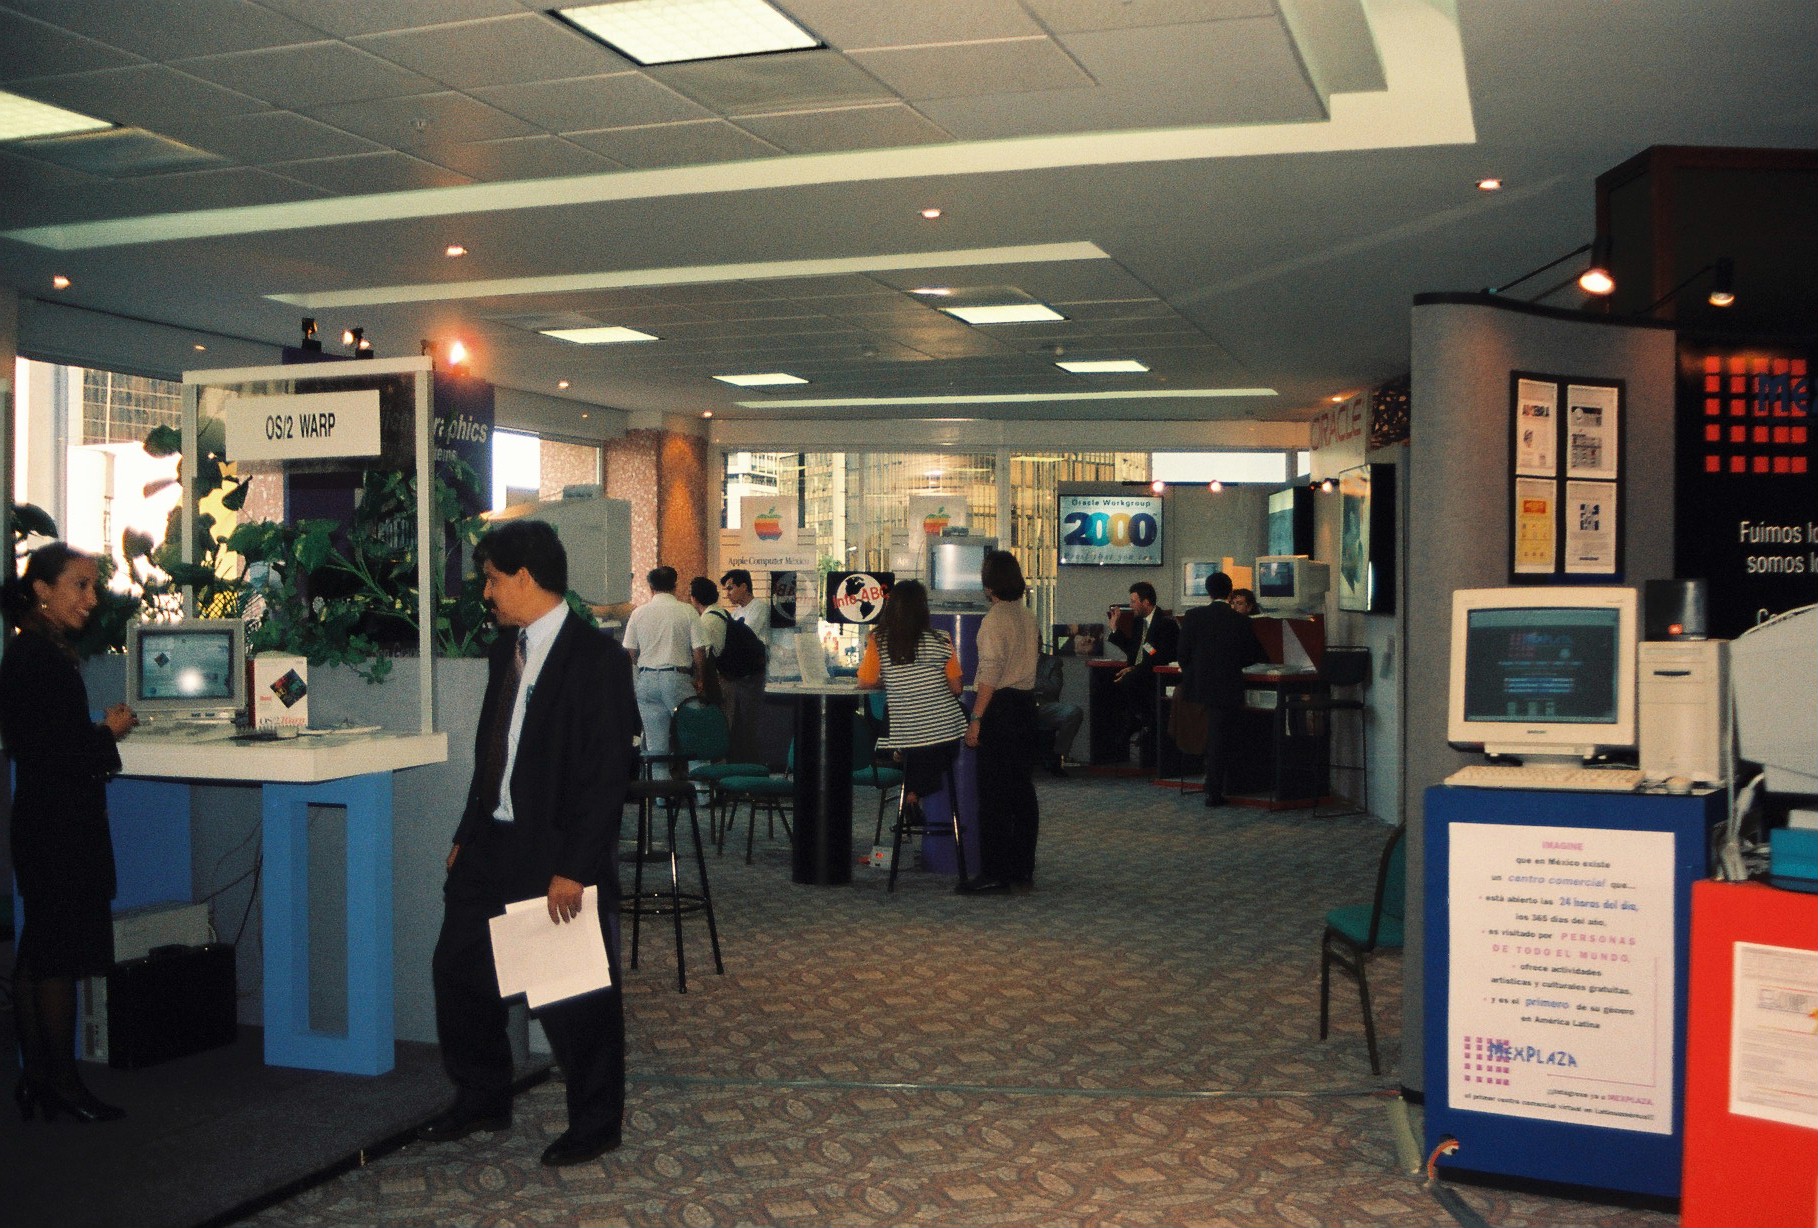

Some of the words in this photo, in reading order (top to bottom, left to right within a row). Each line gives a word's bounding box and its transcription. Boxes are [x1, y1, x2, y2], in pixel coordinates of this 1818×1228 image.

[265, 414, 293, 440] OS/2
[299, 412, 336, 438] WARP
[1310, 398, 1362, 451] ORACLE
[1071, 498, 1100, 507] Oracle
[1103, 499, 1151, 508] Workgroup
[1063, 511, 1158, 548] 2000
[1740, 520, 1803, 543] Fuimos
[728, 557, 749, 568] Apple
[749, 557, 784, 567] Computer
[1746, 554, 1805, 573] somos
[833, 594, 858, 610] Info
[860, 584, 889, 602] ABC
[1541, 841, 1584, 851] IMAGINE
[1515, 857, 1531, 866] que
[1583, 860, 1611, 869] existe
[1508, 874, 1545, 885] centro
[1549, 876, 1606, 888] comercial
[1507, 896, 1538, 905] abierto
[1559, 897, 1572, 907] 24
[1574, 898, 1600, 909] horas
[1603, 900, 1618, 910] del
[1515, 913, 1530, 921] los
[1531, 914, 1548, 922] 365
[1572, 916, 1585, 925] del
[1501, 928, 1536, 938] visitado
[1538, 932, 1553, 940] por
[1560, 932, 1637, 946] PERSONAS
[1492, 944, 1509, 954] DE
[1516, 946, 1551, 957] TODO
[1556, 949, 1571, 958] EL
[1520, 963, 1549, 973] ofrece
[1551, 966, 1602, 977] actividades
[1542, 980, 1586, 991] culturales
[1525, 997, 1570, 1010] primero
[1576, 1003, 1588, 1011] de
[1572, 1019, 1601, 1029] Latina
[1522, 1099, 1556, 1109] comercial
